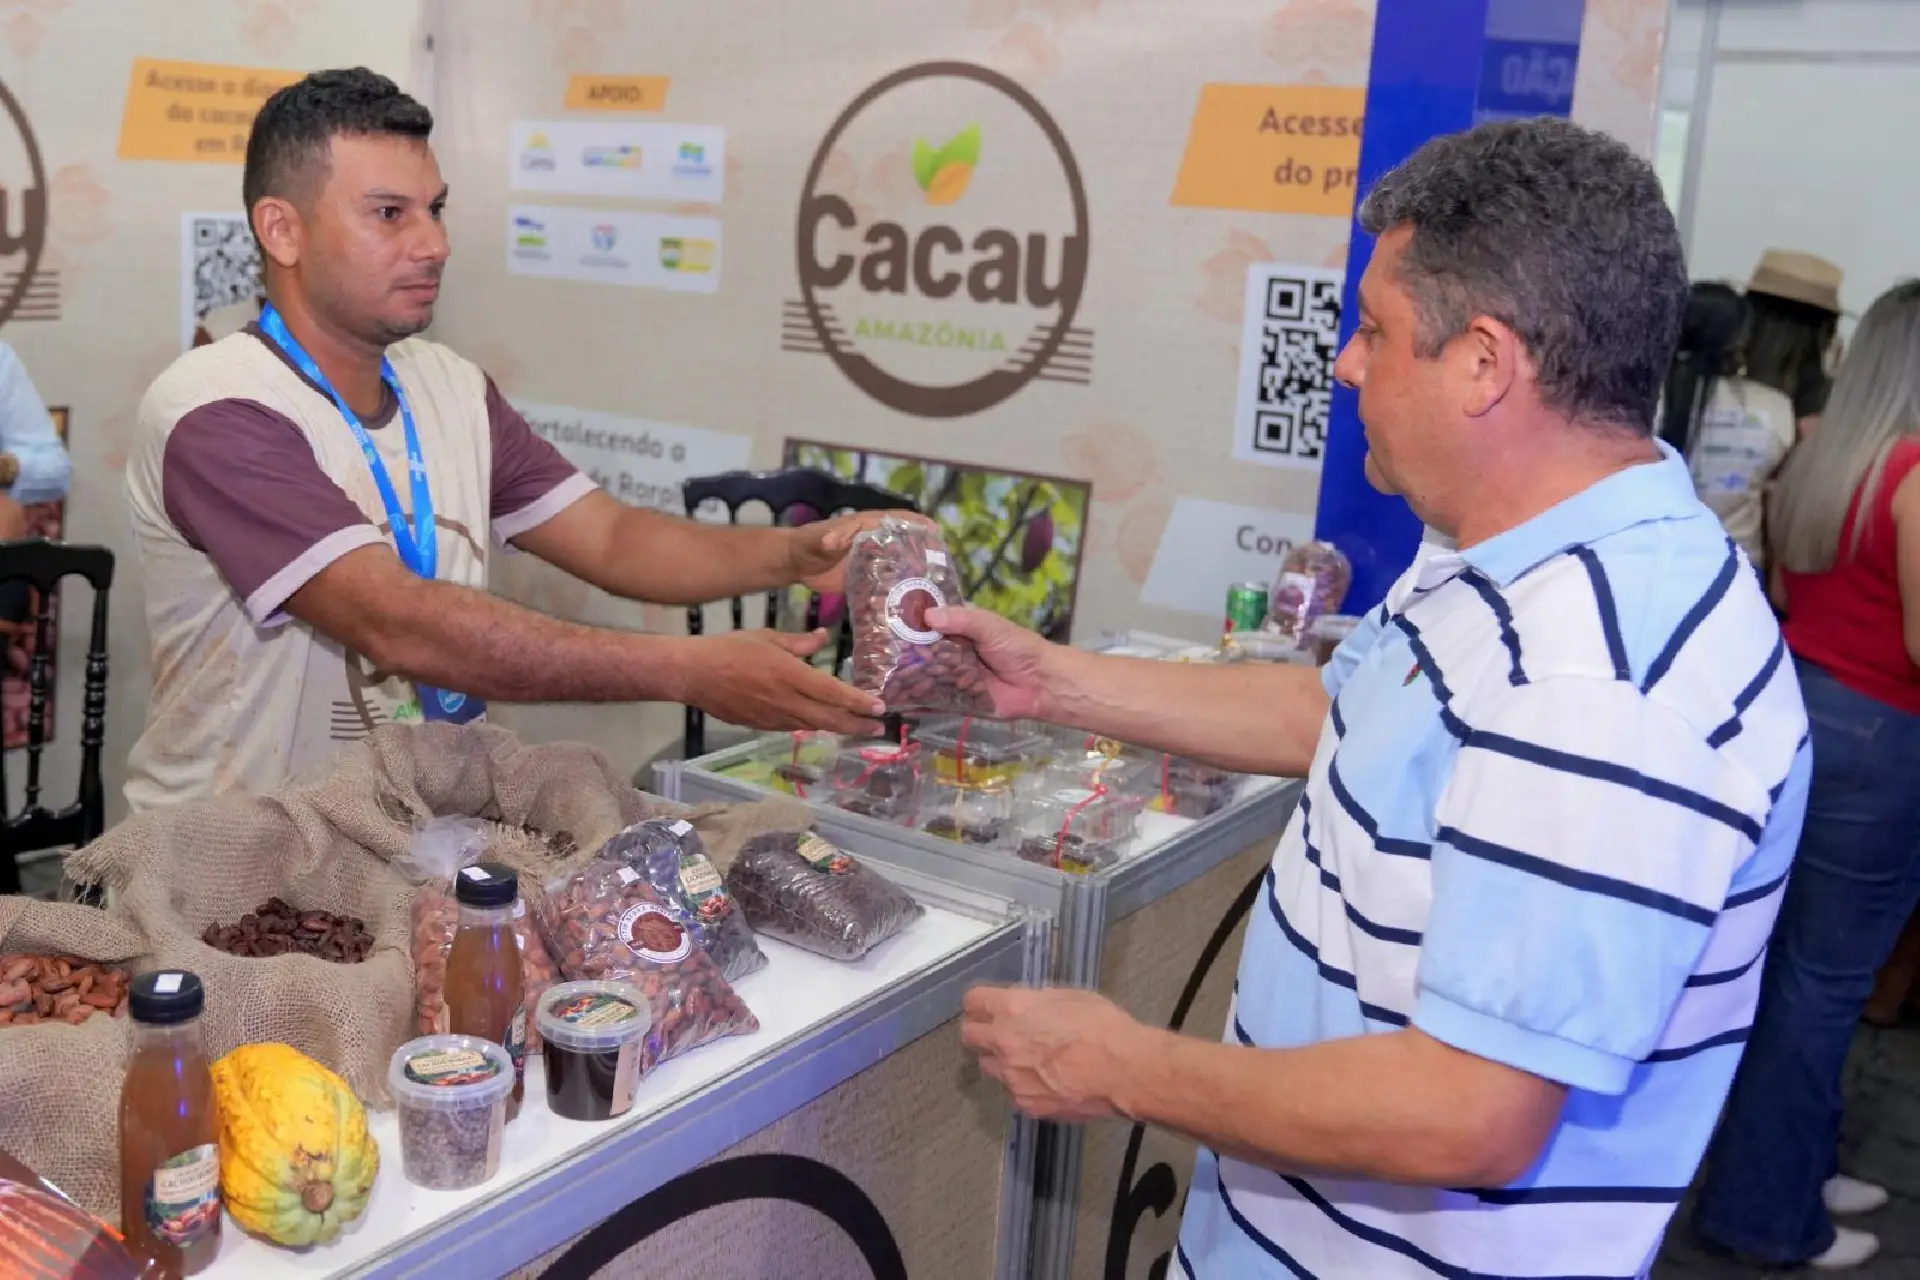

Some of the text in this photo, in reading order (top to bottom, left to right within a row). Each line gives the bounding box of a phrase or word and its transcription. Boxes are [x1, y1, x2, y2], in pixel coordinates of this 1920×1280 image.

[1274, 157, 1313, 186] do
[797, 194, 1088, 308] Cacau
[854, 318, 1006, 352] AMAZÔNIA
